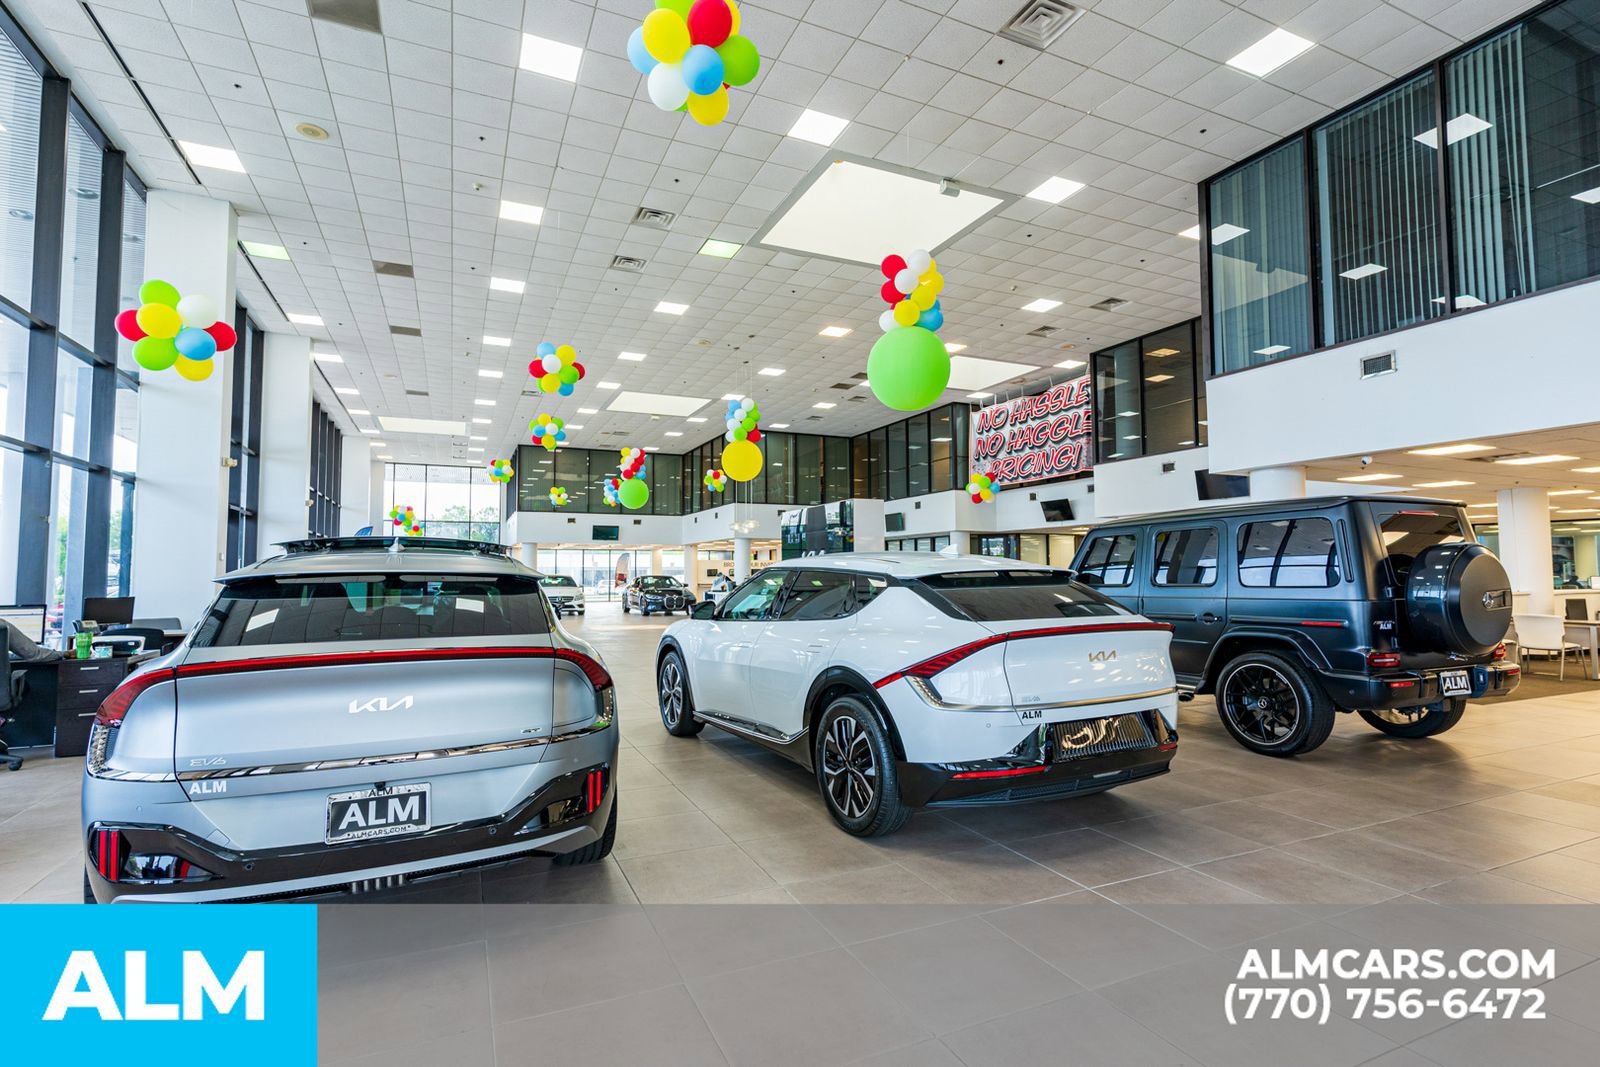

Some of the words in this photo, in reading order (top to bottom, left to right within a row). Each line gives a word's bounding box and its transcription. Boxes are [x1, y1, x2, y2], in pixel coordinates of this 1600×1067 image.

[977, 404, 1009, 434] NO
[1009, 379, 1092, 425] HASSLE
[974, 432, 1004, 461] NO
[1006, 409, 1092, 453] HAGGLE
[990, 441, 1082, 481] PRICING!
[1088, 650, 1116, 662] KIA
[1444, 676, 1468, 690] ALM
[348, 695, 414, 714] KIA
[1021, 710, 1042, 719] ALM
[190, 757, 226, 766] EV6
[189, 780, 227, 794] ALM
[338, 795, 420, 831] ALM
